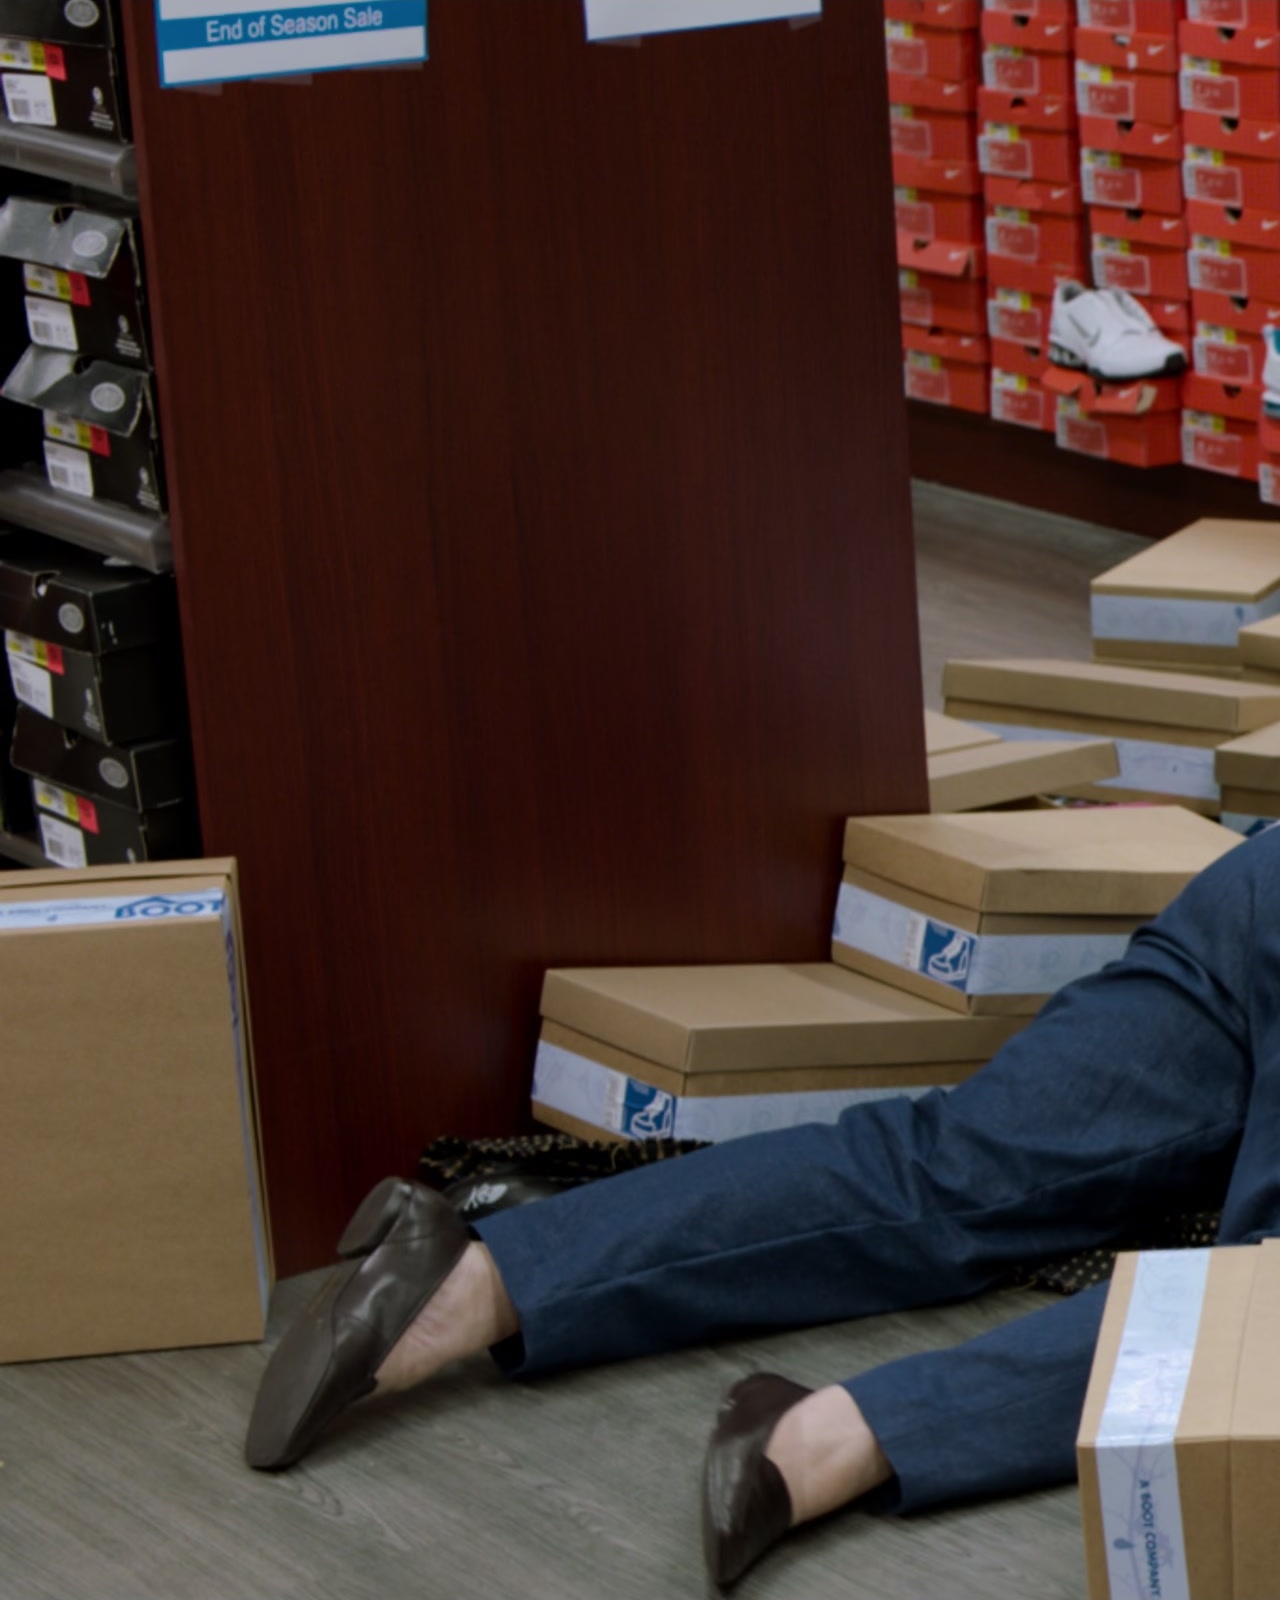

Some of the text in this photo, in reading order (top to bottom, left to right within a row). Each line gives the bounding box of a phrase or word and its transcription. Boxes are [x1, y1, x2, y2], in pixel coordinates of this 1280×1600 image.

[206, 6, 383, 43] End of Season Sale
[114, 900, 224, 919] BOOT
[1139, 1480, 1161, 1598] A BOOT COMPANY
